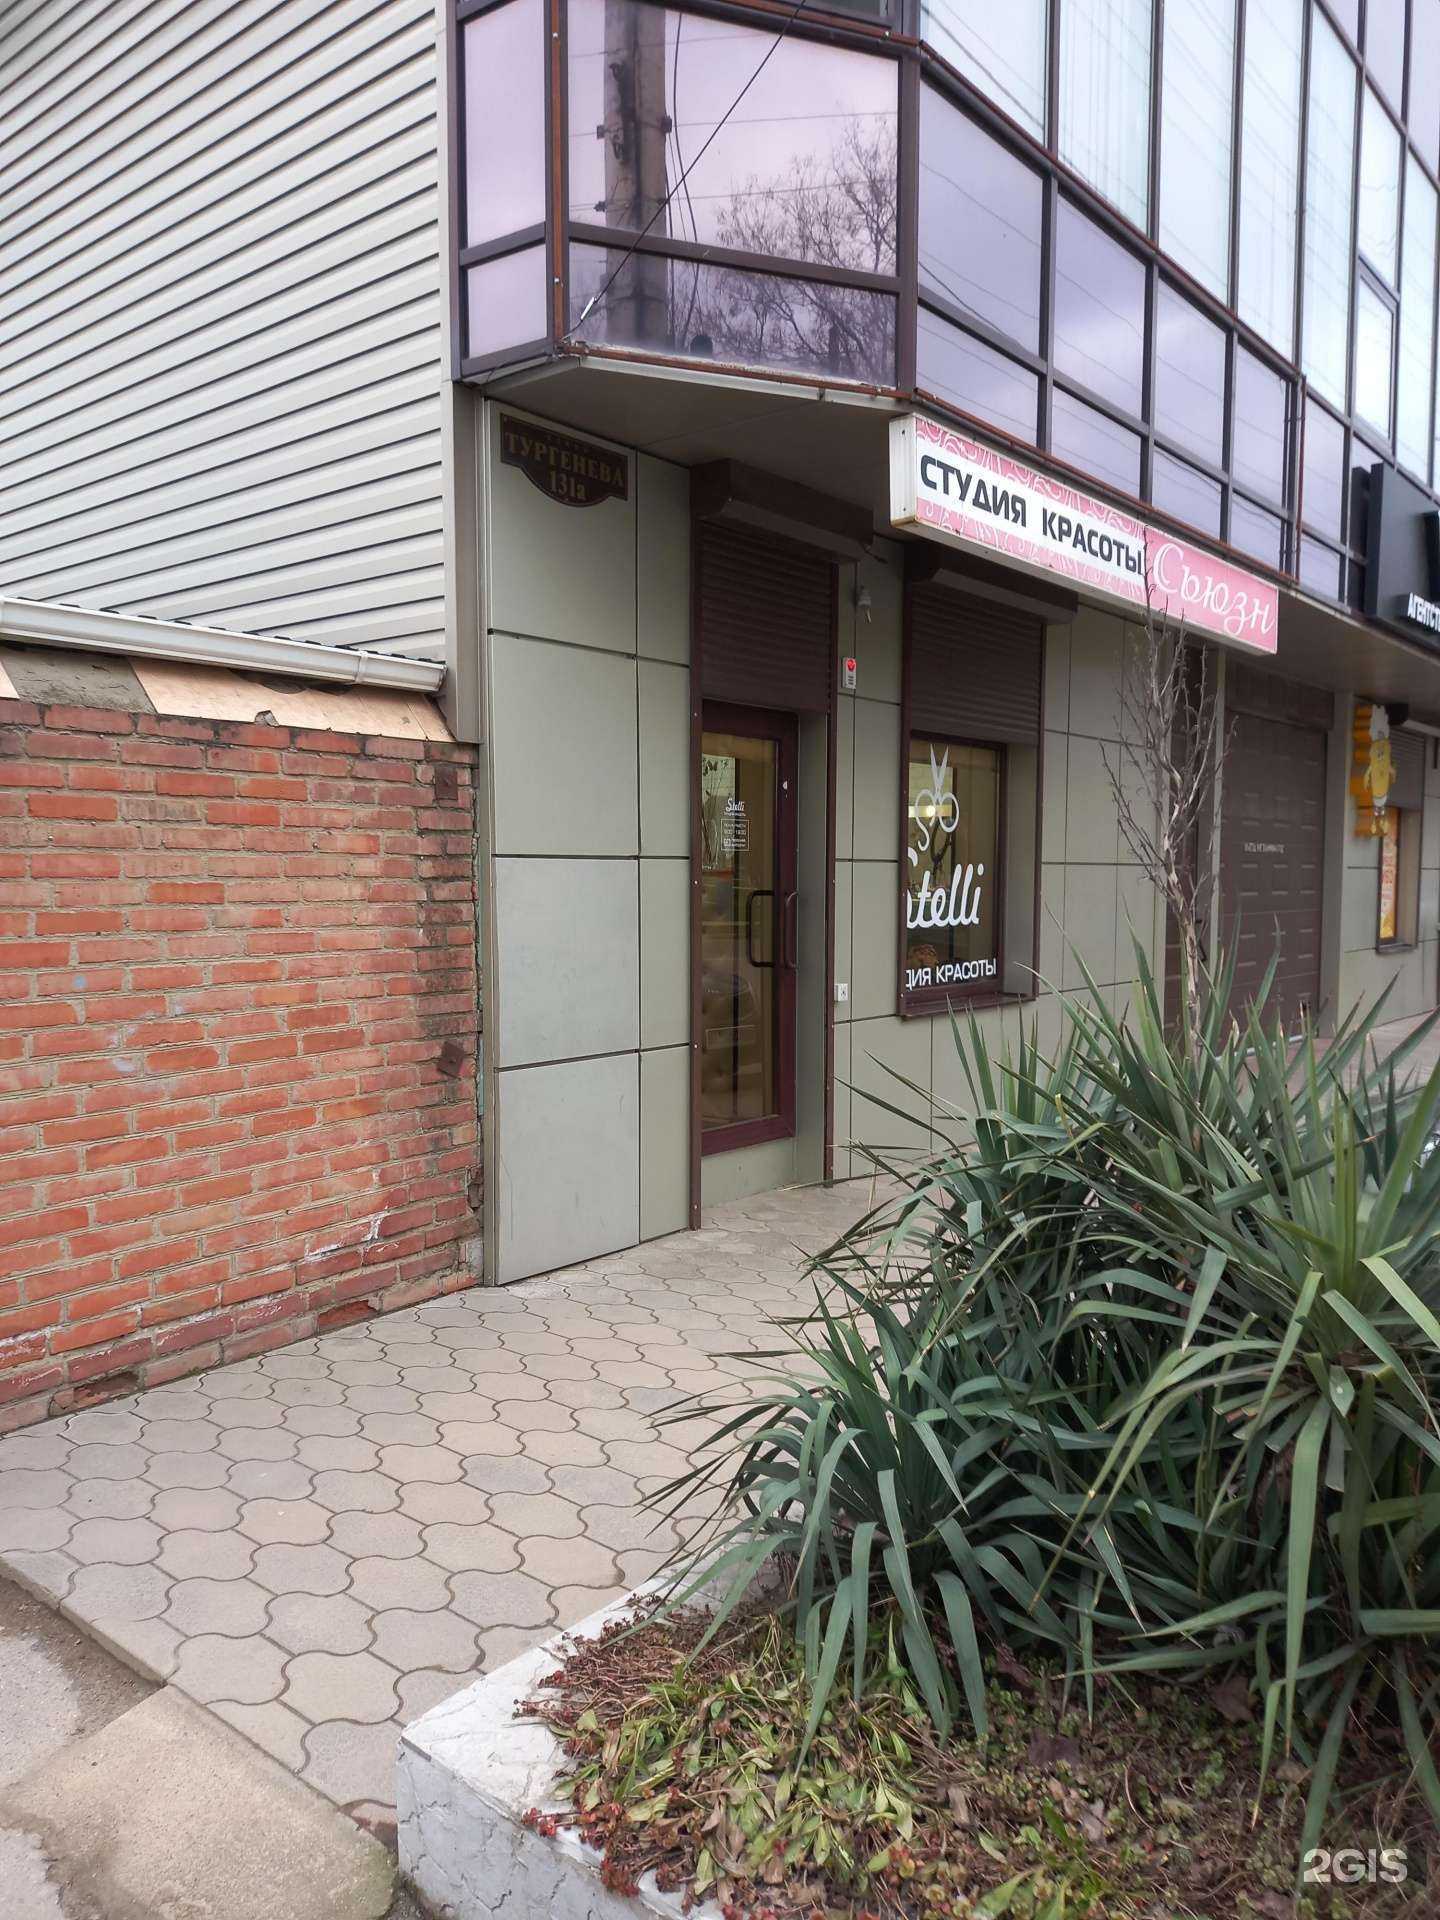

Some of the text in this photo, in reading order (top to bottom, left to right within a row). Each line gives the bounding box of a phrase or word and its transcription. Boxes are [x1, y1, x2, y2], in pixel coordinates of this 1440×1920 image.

[505, 432, 624, 487] ТУРГЕНЕВА
[920, 455, 1142, 576] СТУДИЯ КРАСОТЫ
[1153, 543, 1275, 636] Сьюзн
[936, 958, 996, 983] КРАСОТЫ
